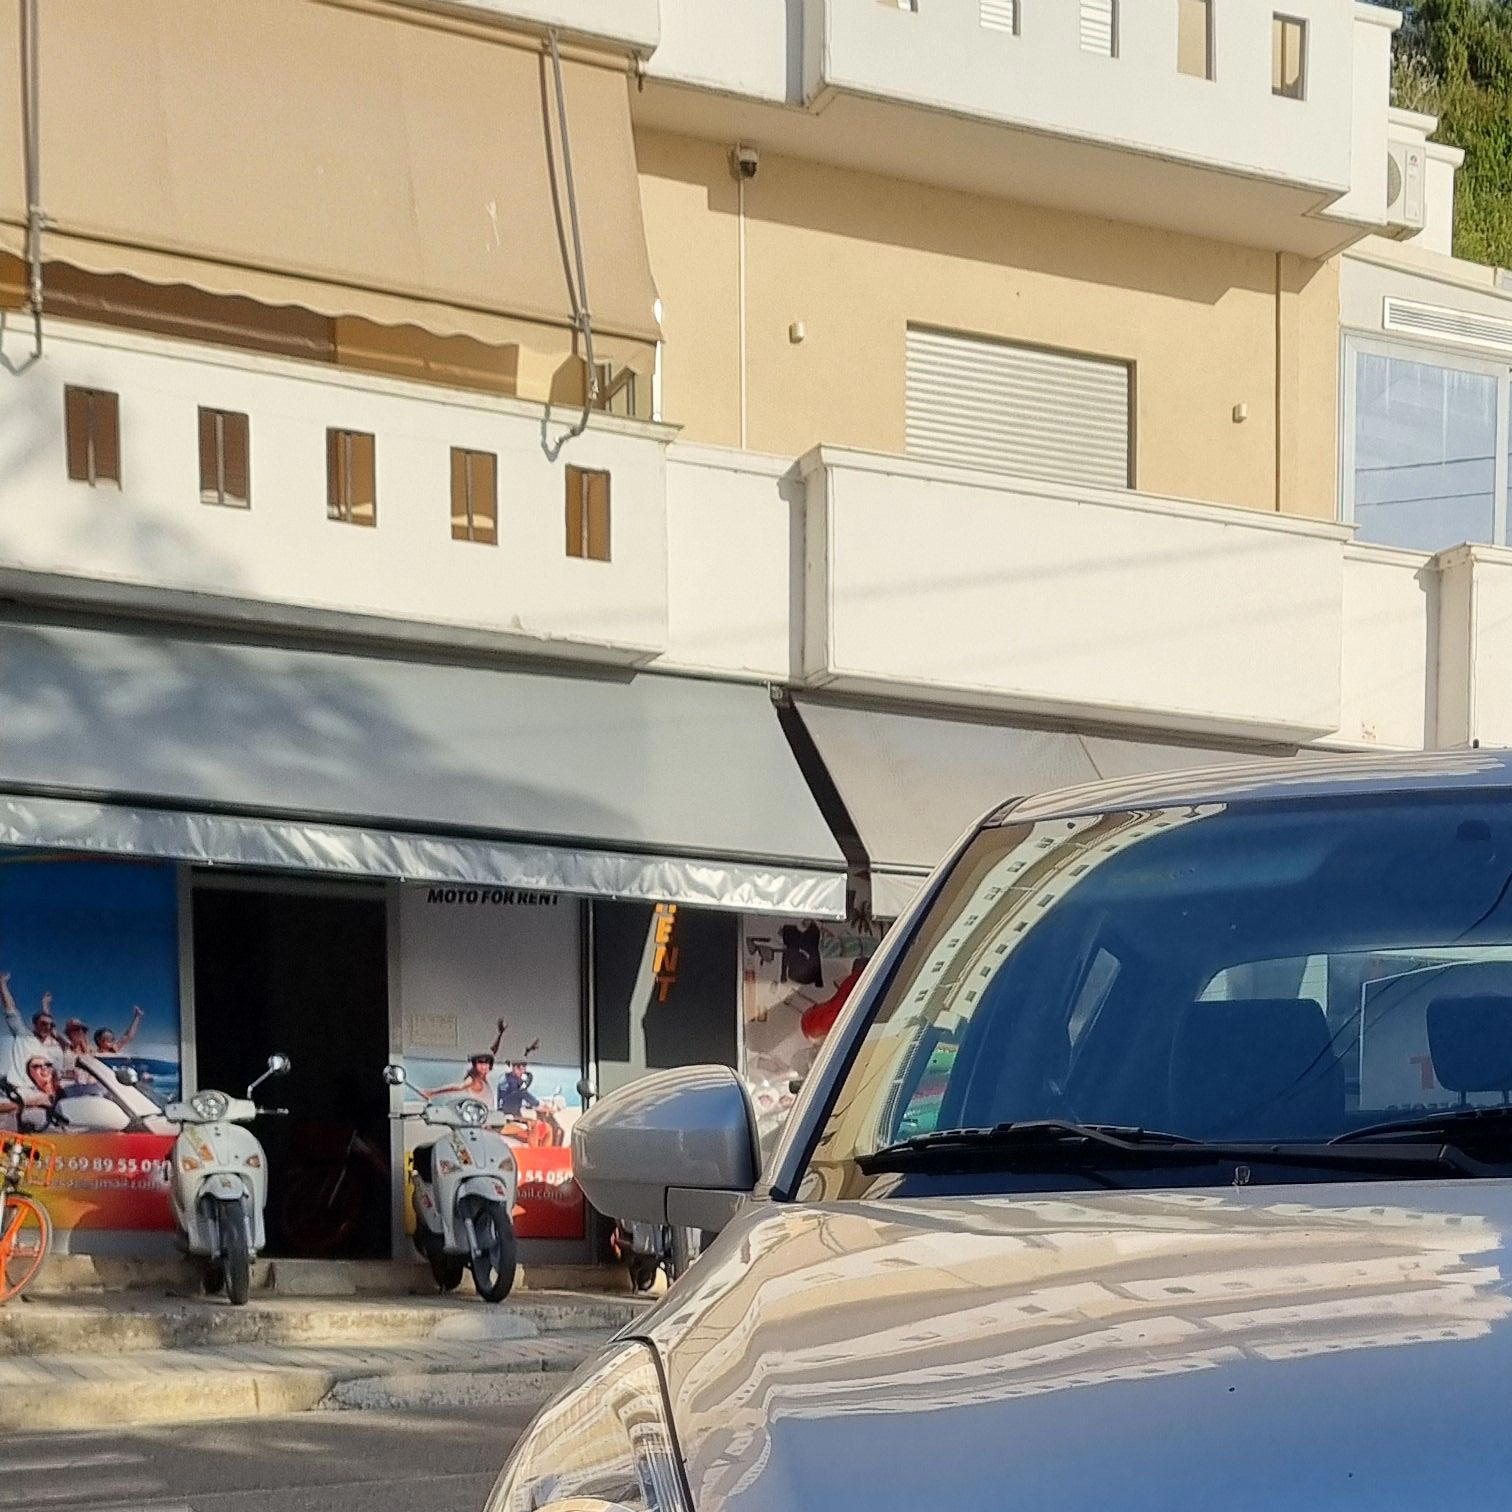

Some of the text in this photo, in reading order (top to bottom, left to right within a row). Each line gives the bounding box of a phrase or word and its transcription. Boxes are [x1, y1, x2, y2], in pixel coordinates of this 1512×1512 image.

[427, 888, 559, 905] MOTO FOR RENT
[117, 1158, 137, 1173] 55
